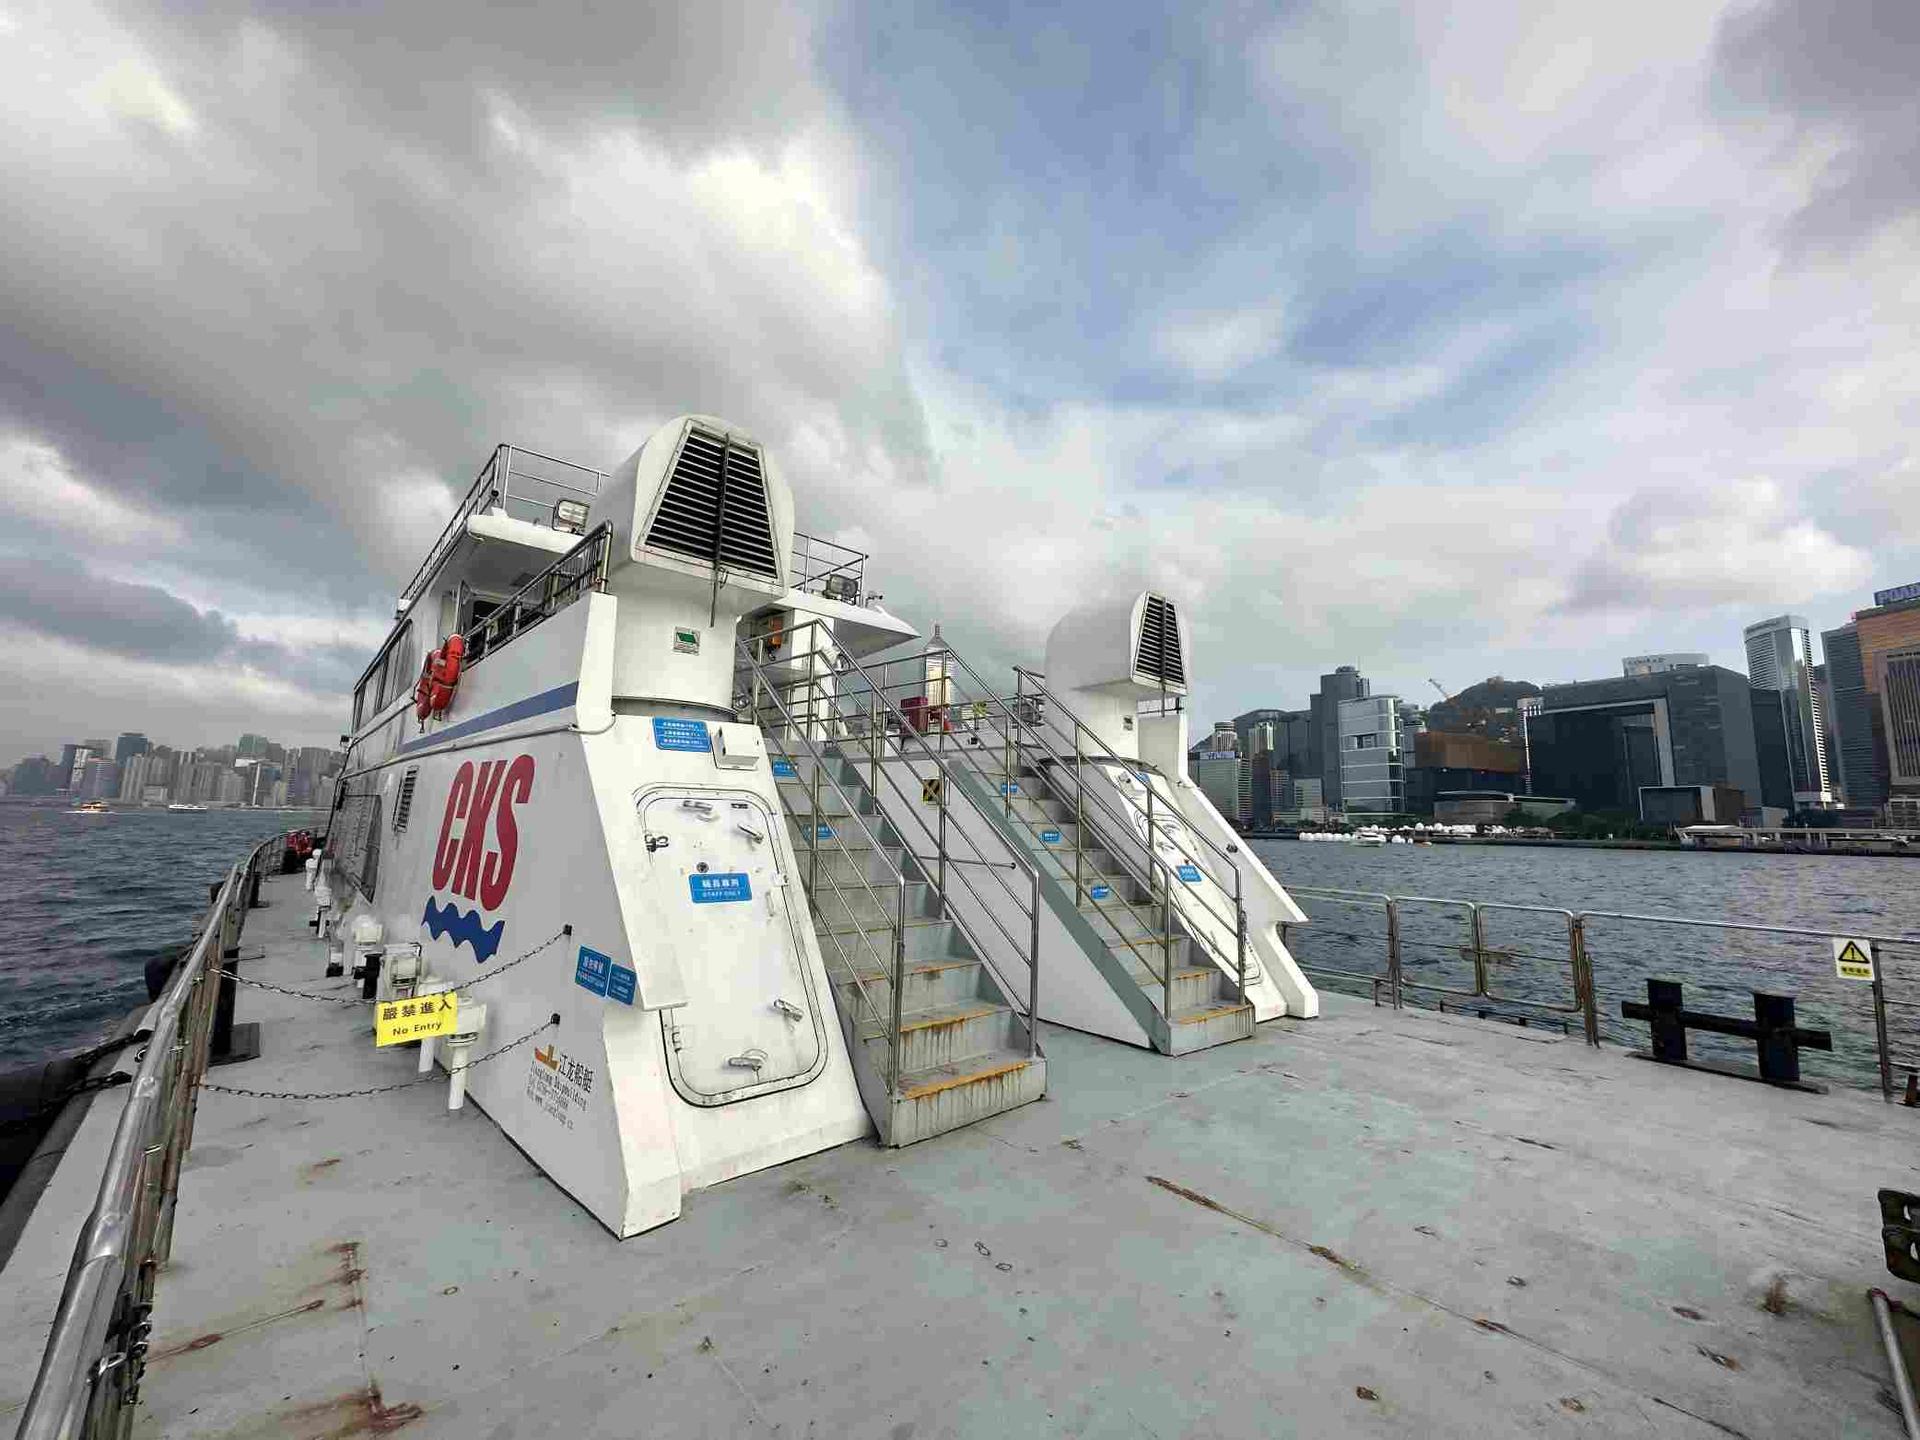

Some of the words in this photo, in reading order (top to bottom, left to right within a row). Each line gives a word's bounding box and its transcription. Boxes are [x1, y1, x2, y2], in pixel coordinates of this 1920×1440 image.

[432, 754, 535, 911] CKS
[383, 998, 452, 1020] 嚴禁進入
[393, 1027, 408, 1036] No
[414, 1022, 442, 1032] Entry
